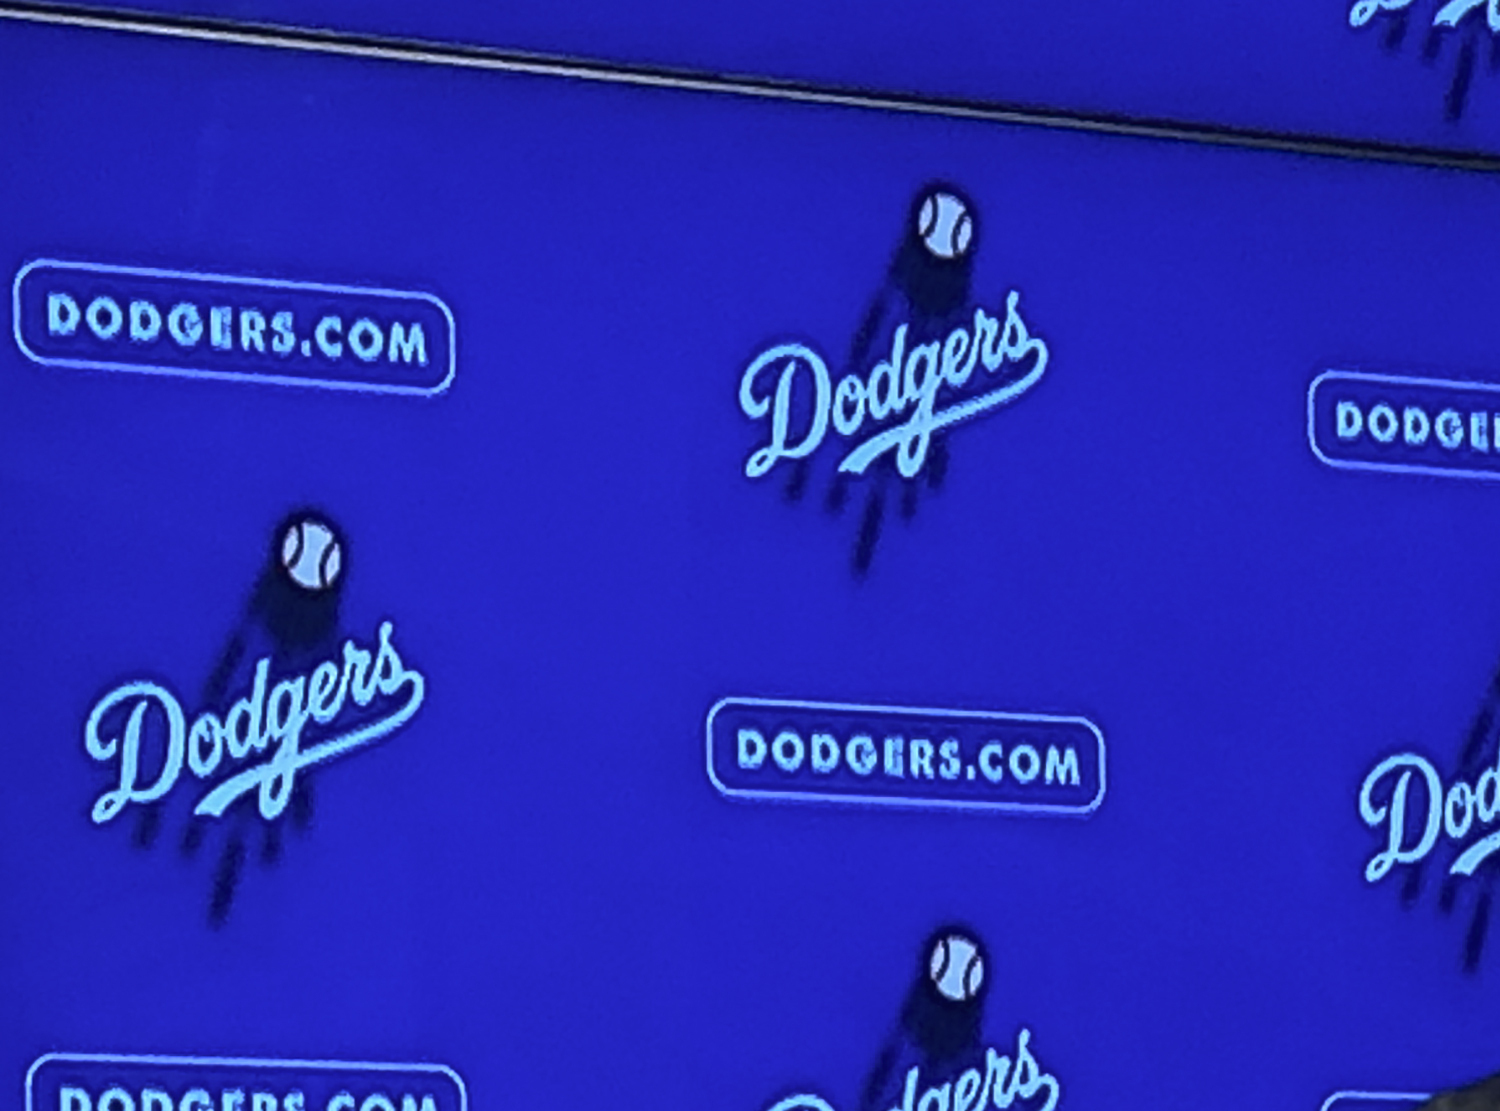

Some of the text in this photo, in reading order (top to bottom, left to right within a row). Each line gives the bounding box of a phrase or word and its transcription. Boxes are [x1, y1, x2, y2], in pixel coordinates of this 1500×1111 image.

[47, 292, 429, 367] DODGERS.COM
[740, 291, 1048, 477] Dodgers
[86, 622, 424, 823] Dodgers
[736, 728, 1082, 787] DODGERS.COM
